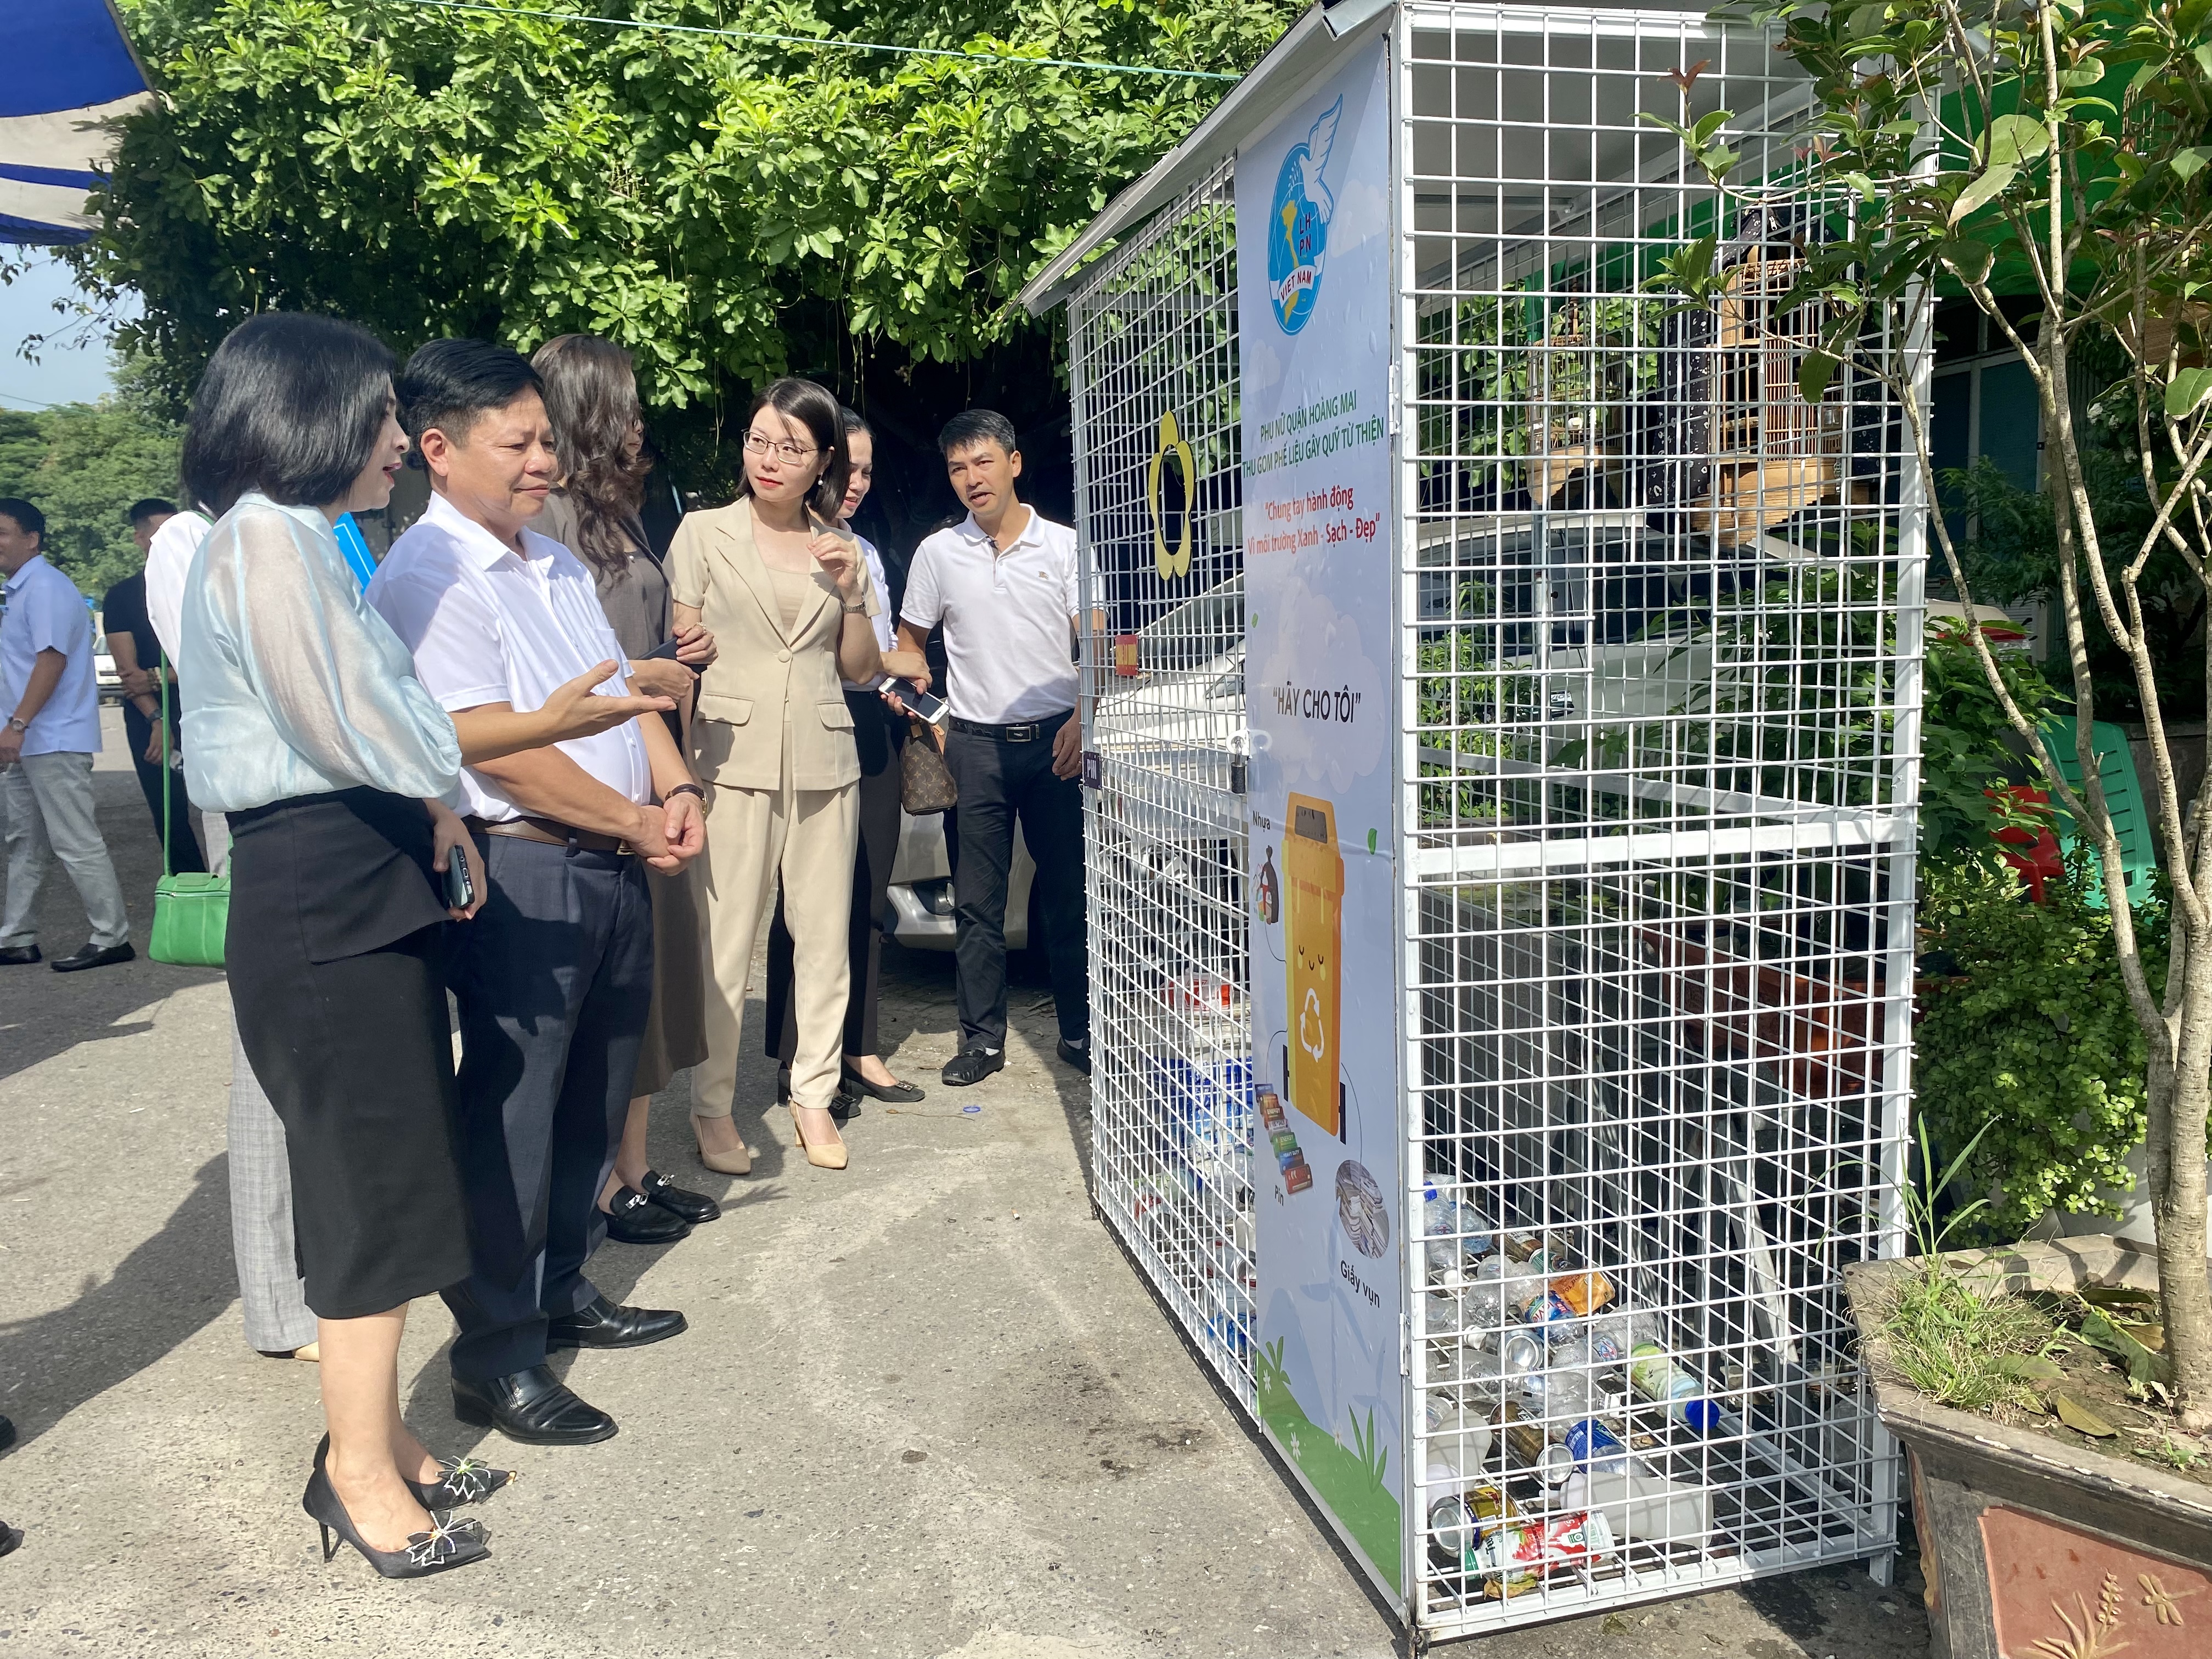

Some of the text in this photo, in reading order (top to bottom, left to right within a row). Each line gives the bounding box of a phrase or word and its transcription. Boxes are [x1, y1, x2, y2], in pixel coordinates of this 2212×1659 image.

[1299, 211, 1312, 234] LH
[1299, 234, 1312, 256] PN
[1296, 270, 1312, 285] NAM
[1261, 390, 1357, 444] PHỤ NỮ QUẬN HOÀNG MAI
[1242, 414, 1384, 478] THU GOM PHẾ LIỆU GÂY QUỸ TỪ THIỆN
[1293, 498, 1305, 520] tay
[1307, 488, 1328, 512] hành
[1330, 484, 1354, 511] động
[1248, 535, 1255, 555] Vì
[1256, 534, 1270, 555] môi
[1272, 531, 1296, 554] trường
[1297, 525, 1318, 548] Xanh
[1325, 519, 1347, 548] Sạch
[1303, 689, 1330, 720] CHO
[1252, 810, 1271, 832] Nhựa
[1274, 1184, 1284, 1206] Pin
[1340, 1260, 1381, 1308] Giấy vụn
